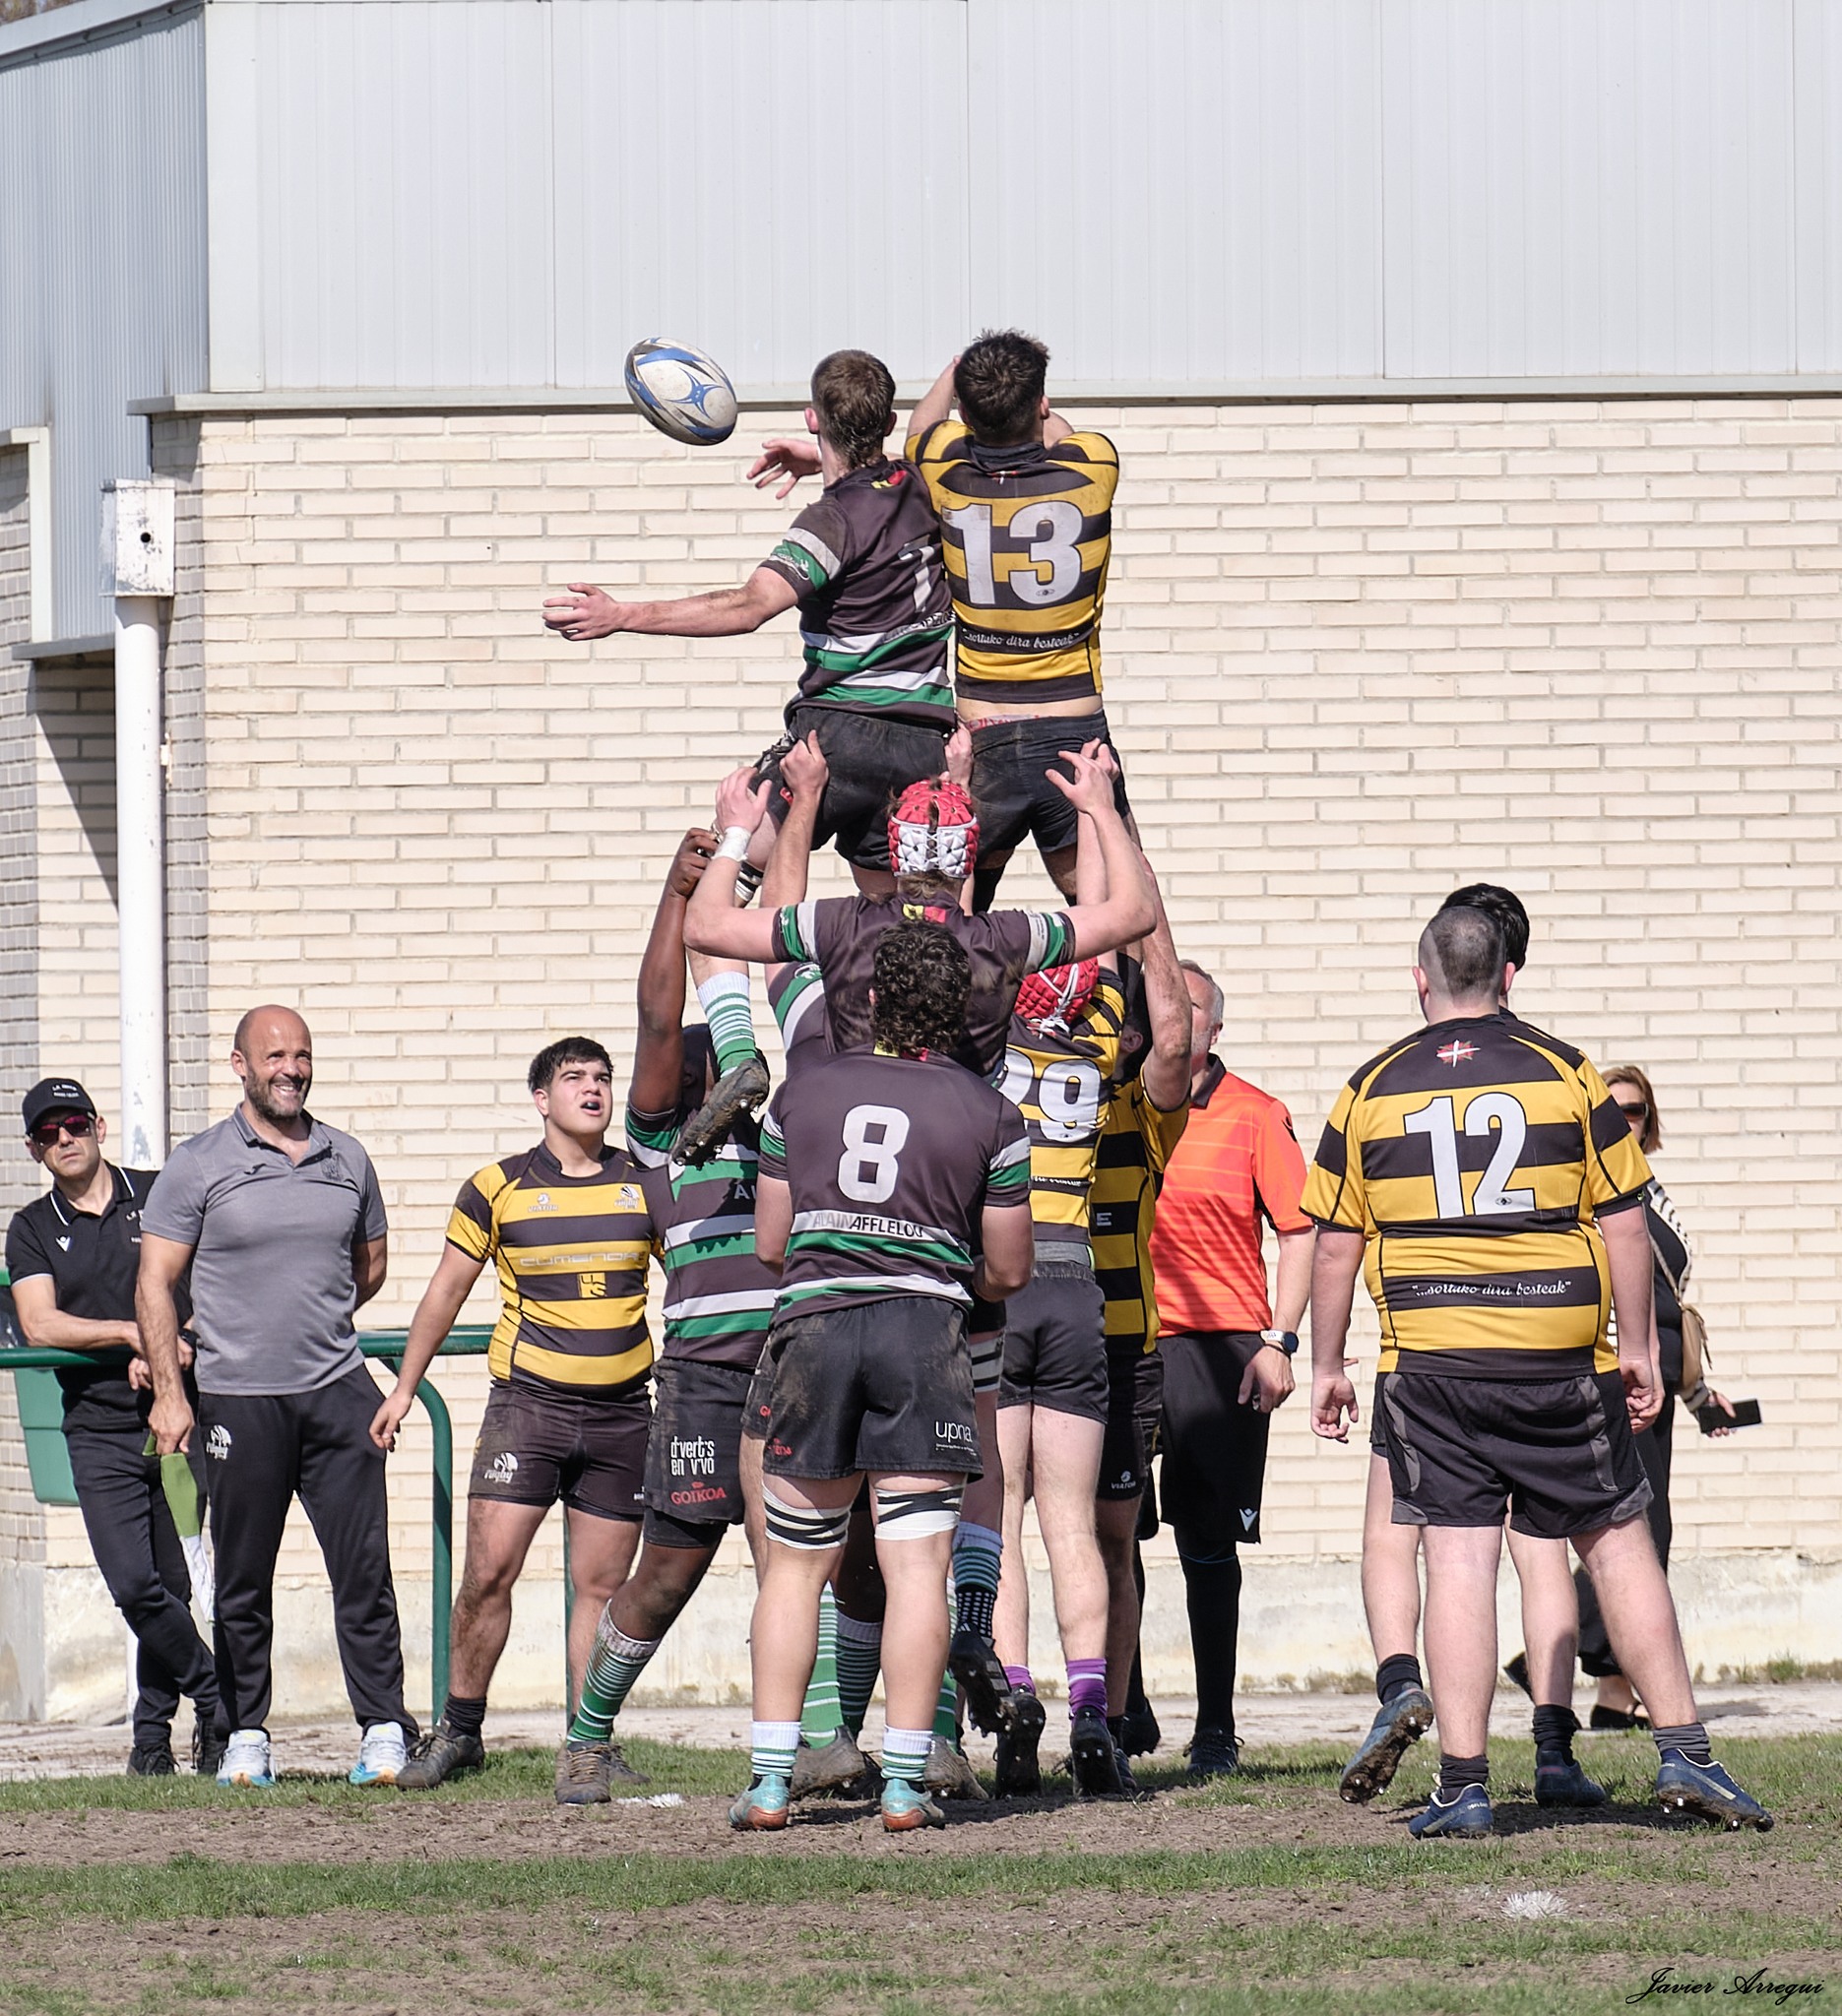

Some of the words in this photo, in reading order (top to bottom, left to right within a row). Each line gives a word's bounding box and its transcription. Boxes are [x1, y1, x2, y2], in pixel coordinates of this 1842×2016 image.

[941, 499, 1083, 604] 13
[837, 1103, 911, 1204] 8
[1404, 1092, 1536, 1220] 12
[934, 1420, 973, 1443] upna
[670, 1486, 727, 1505] GOIKOA
